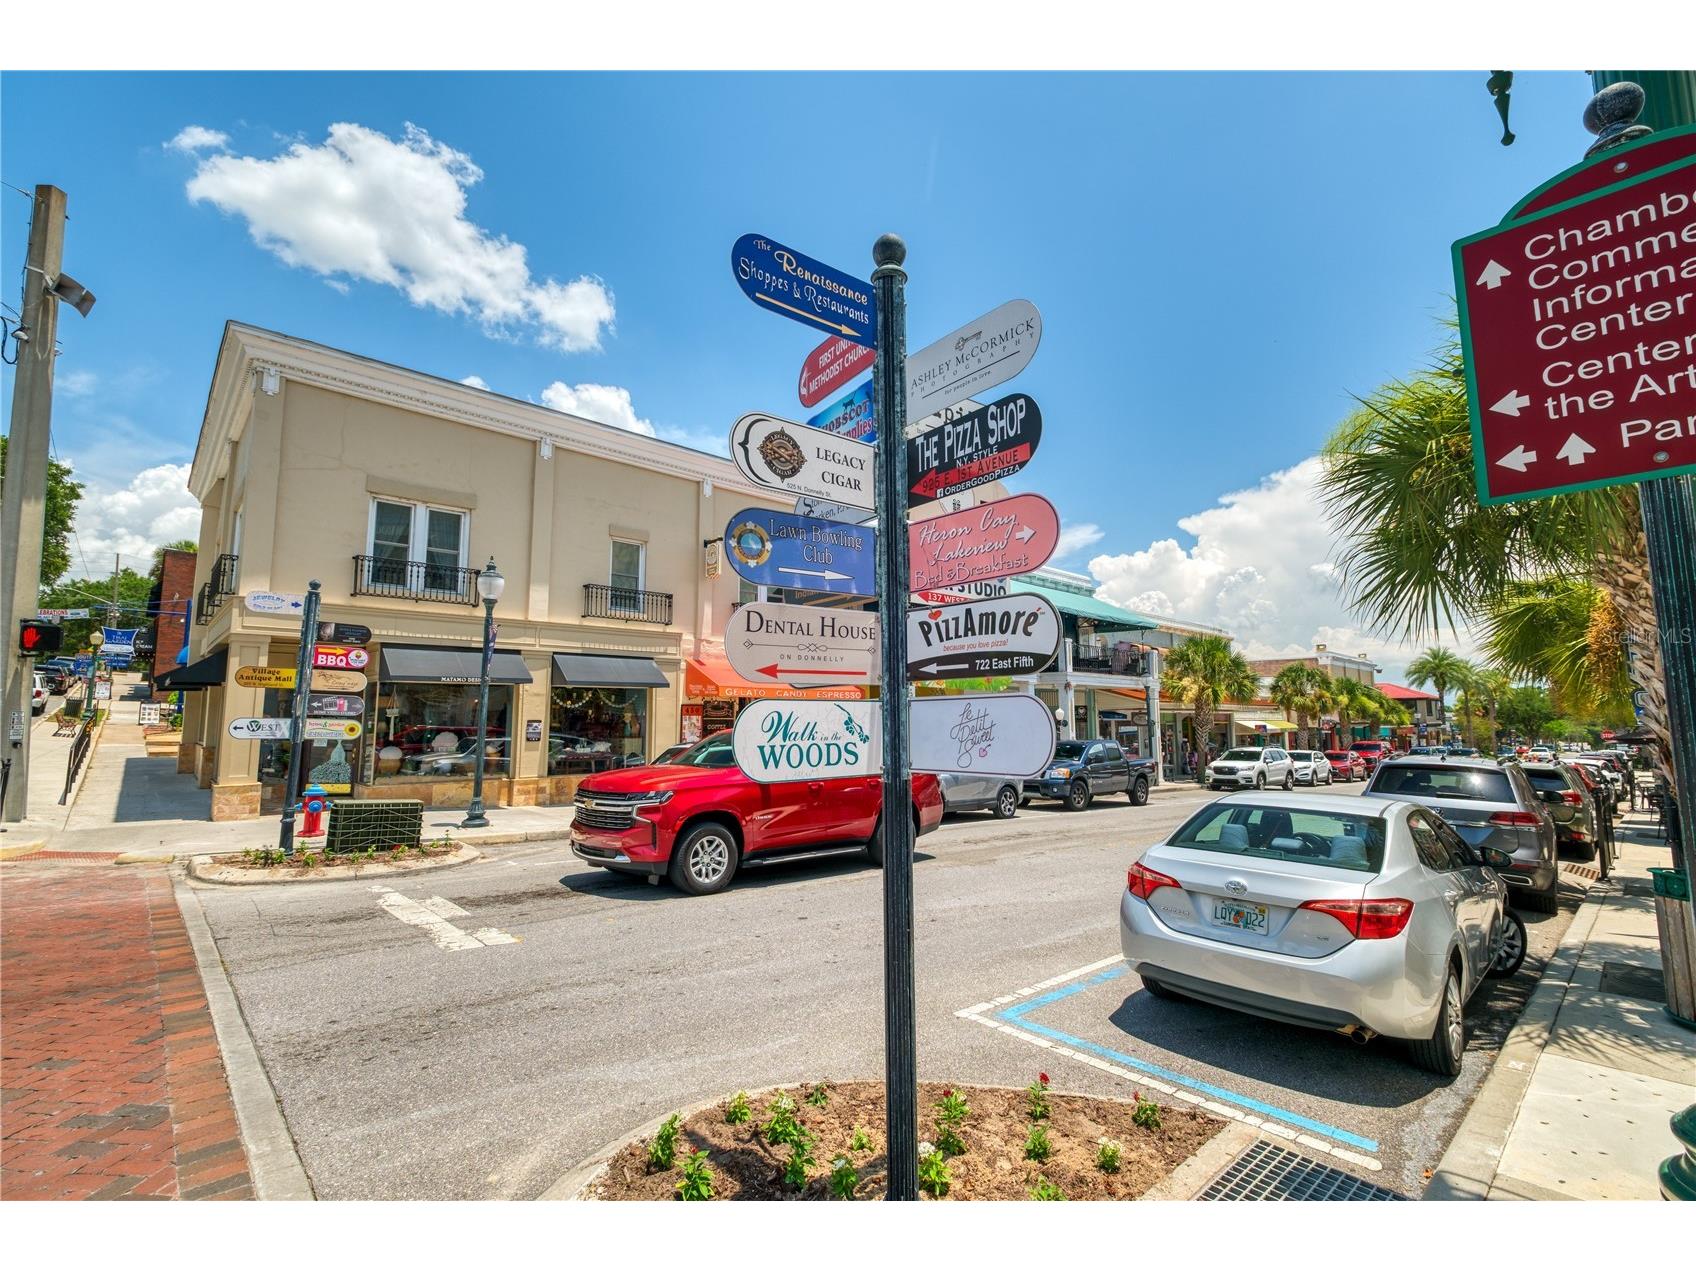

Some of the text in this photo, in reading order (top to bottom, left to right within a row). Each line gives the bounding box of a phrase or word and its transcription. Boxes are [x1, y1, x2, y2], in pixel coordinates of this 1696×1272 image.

[1524, 189, 1696, 261] Chamb
[753, 239, 771, 251] The
[774, 250, 868, 306] Renaissance
[739, 257, 869, 325] Shoppes & Restaurants
[1536, 292, 1694, 350] Center
[818, 346, 836, 369] FIRST
[911, 317, 1035, 389] ASHLEY McCORMICK
[809, 345, 870, 394] METHODIST CHURC
[1545, 390, 1614, 420] the
[915, 435, 939, 473] THE
[944, 417, 982, 463] PIZZA
[987, 398, 1026, 445] SHOP
[815, 446, 866, 471] LEGACY
[956, 445, 998, 468] N.Y. STYLE
[821, 470, 862, 491] CIGAR
[922, 475, 940, 493] 925
[977, 449, 1019, 475] AVENUE
[945, 464, 1020, 495] ORDERGOODPIZZA
[803, 486, 824, 497] Donnelly
[769, 519, 864, 551] Lawn Bowling
[920, 522, 973, 546] Heron
[803, 544, 833, 565] Club
[929, 538, 1009, 566] Lakeview
[915, 569, 944, 590] Bed
[928, 593, 942, 601] 137
[745, 610, 876, 641] DENTAL HOUSE
[943, 638, 1009, 652] because you love pizza!
[317, 654, 347, 667] BBQ
[780, 653, 844, 663] ON DONNELLY
[975, 655, 1034, 671] 722 East Fifth
[238, 674, 272, 682] Antique
[252, 668, 280, 676] Village
[725, 687, 766, 697] GELATO
[776, 688, 807, 698] CANDY
[816, 690, 862, 699] ESPRESSO
[761, 710, 842, 744] Walk in the
[757, 742, 859, 770] WOODS
